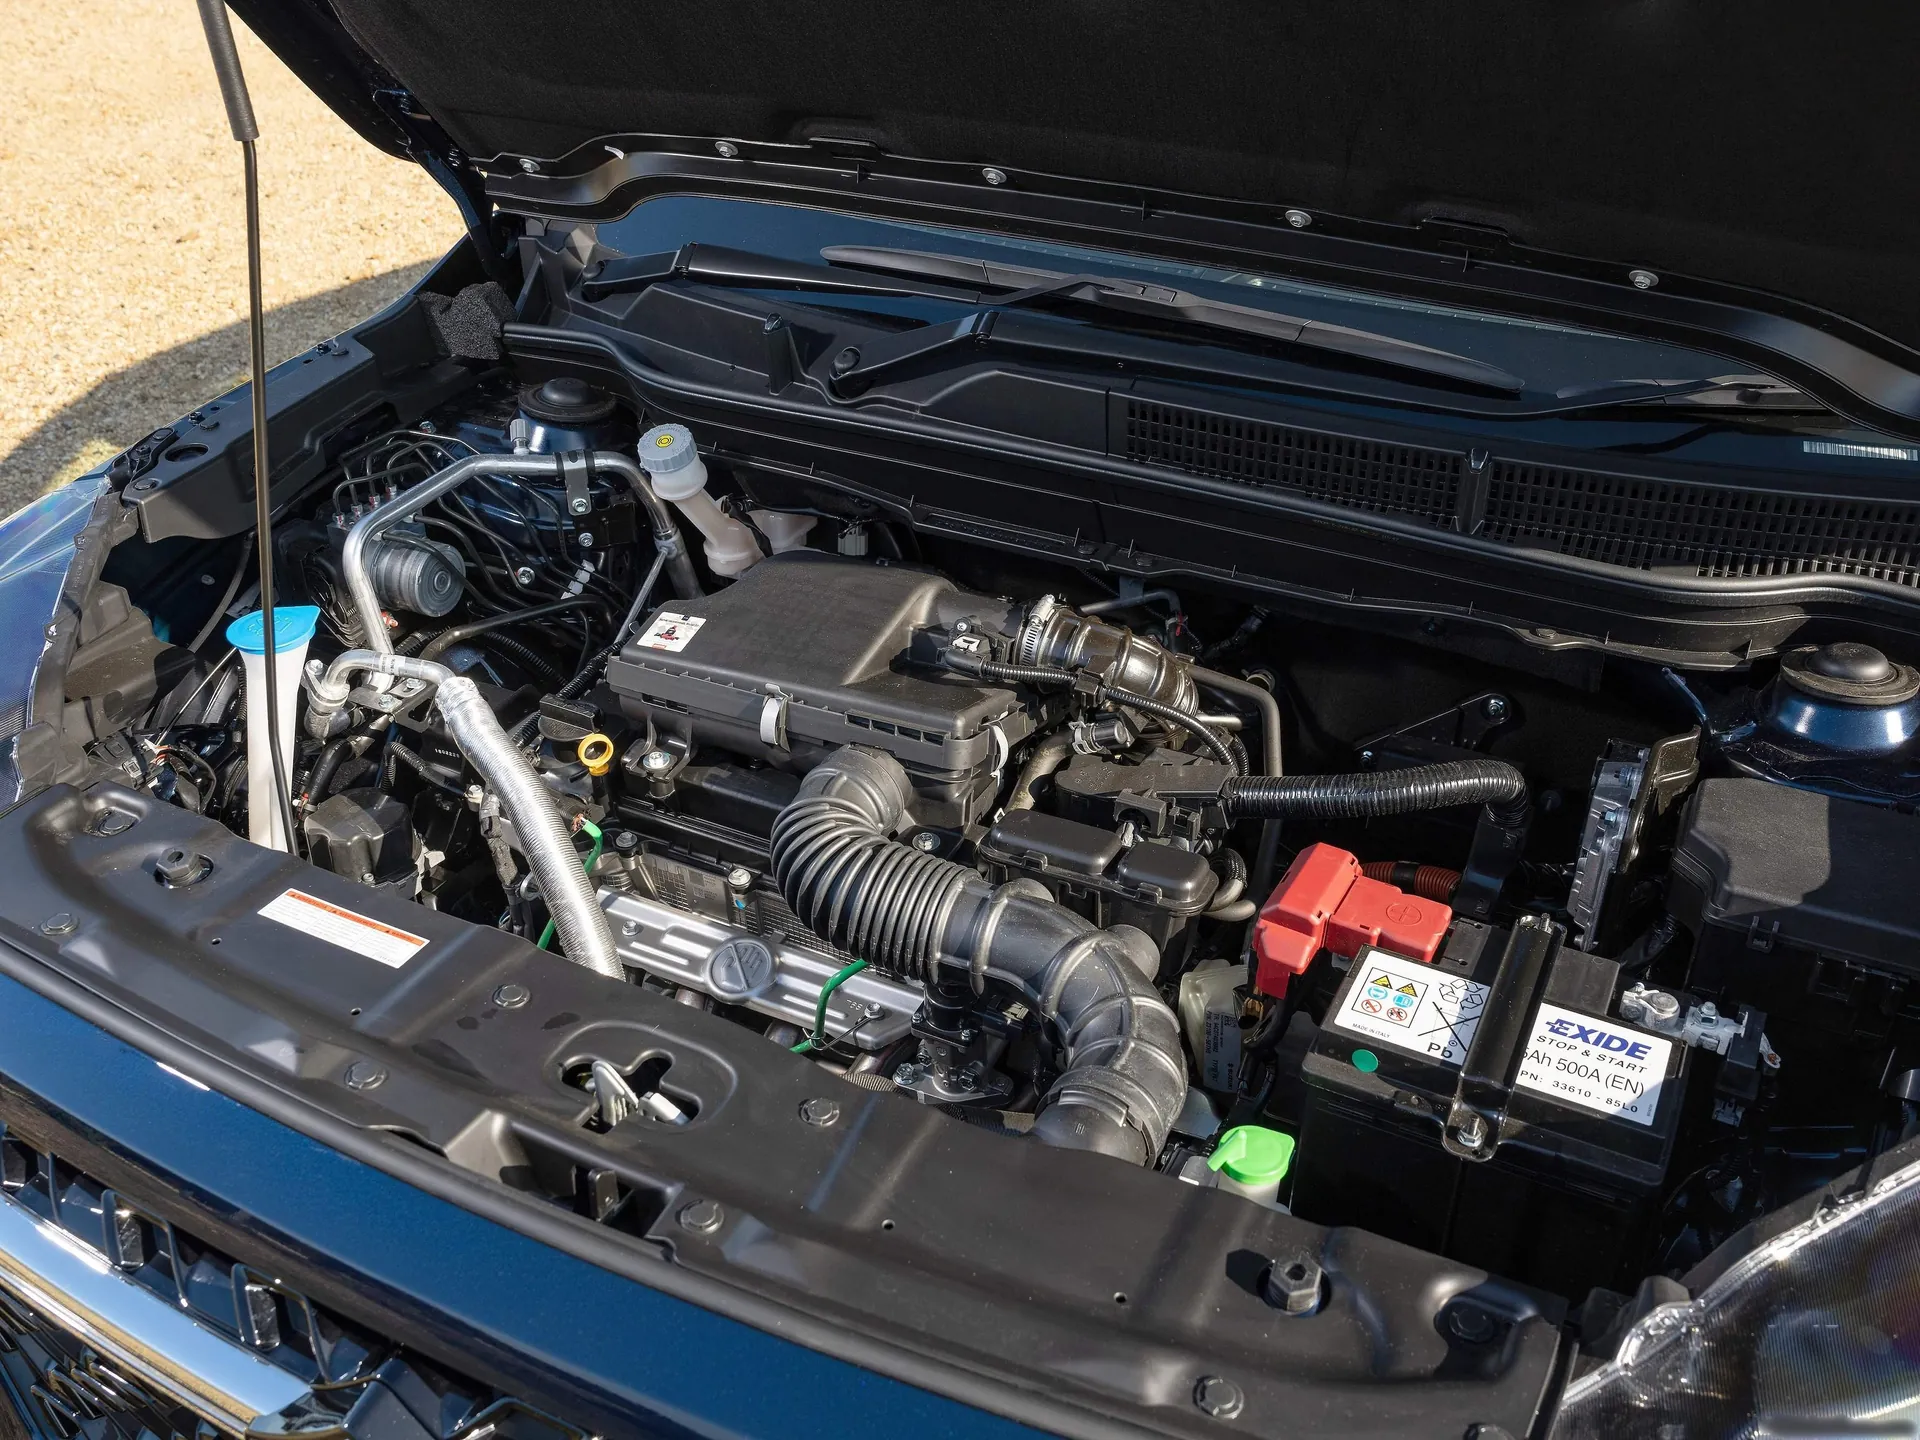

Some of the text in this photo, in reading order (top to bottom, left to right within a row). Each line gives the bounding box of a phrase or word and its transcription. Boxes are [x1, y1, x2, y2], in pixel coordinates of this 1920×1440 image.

[1352, 1023, 1368, 1032] MADE
[1374, 1030, 1390, 1039] ITALY
[1545, 1018, 1652, 1060] EXIDE
[1427, 1042, 1453, 1059] Pb
[1536, 1035, 1648, 1074] STOP & START
[1555, 1057, 1601, 1083] 500A
[1604, 1073, 1645, 1099] (EN)
[1552, 1080, 1592, 1099] 33610
[1605, 1097, 1638, 1113] 85L0
